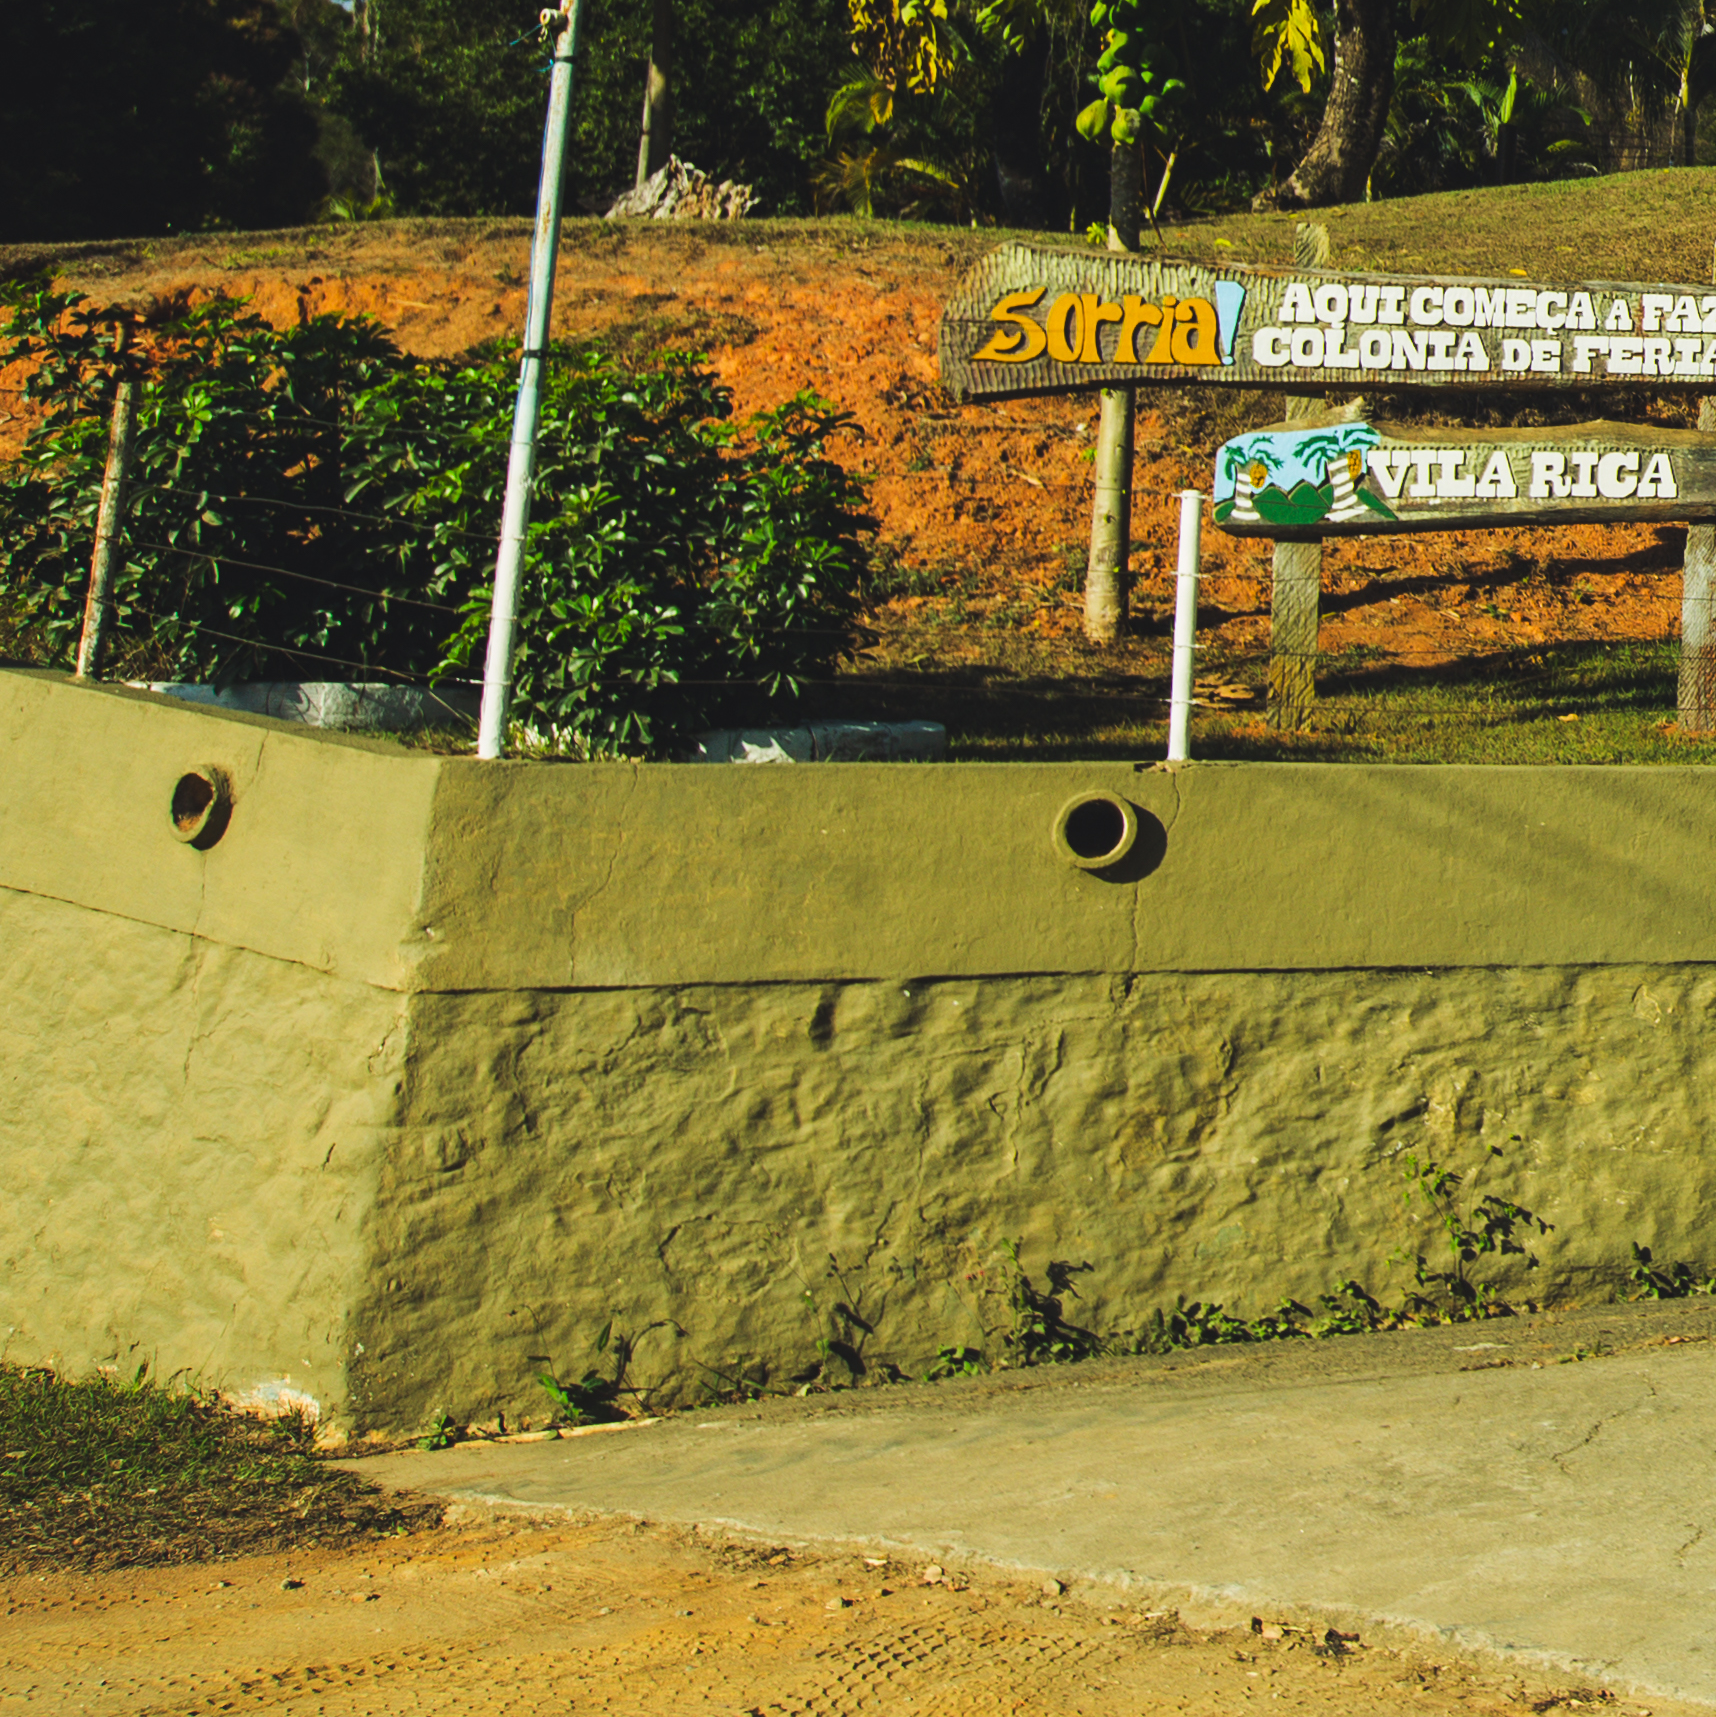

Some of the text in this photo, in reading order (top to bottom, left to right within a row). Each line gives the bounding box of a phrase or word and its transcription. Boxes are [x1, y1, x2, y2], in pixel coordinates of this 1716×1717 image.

[972, 280, 1246, 366] Sorria!
[1278, 282, 1405, 328] AQUI
[1410, 286, 1596, 335] COMEÇA
[1605, 299, 1633, 331] A
[1252, 326, 1491, 371] COLONIA
[1502, 339, 1562, 372] DE
[1367, 450, 1678, 498] VILA RICA
